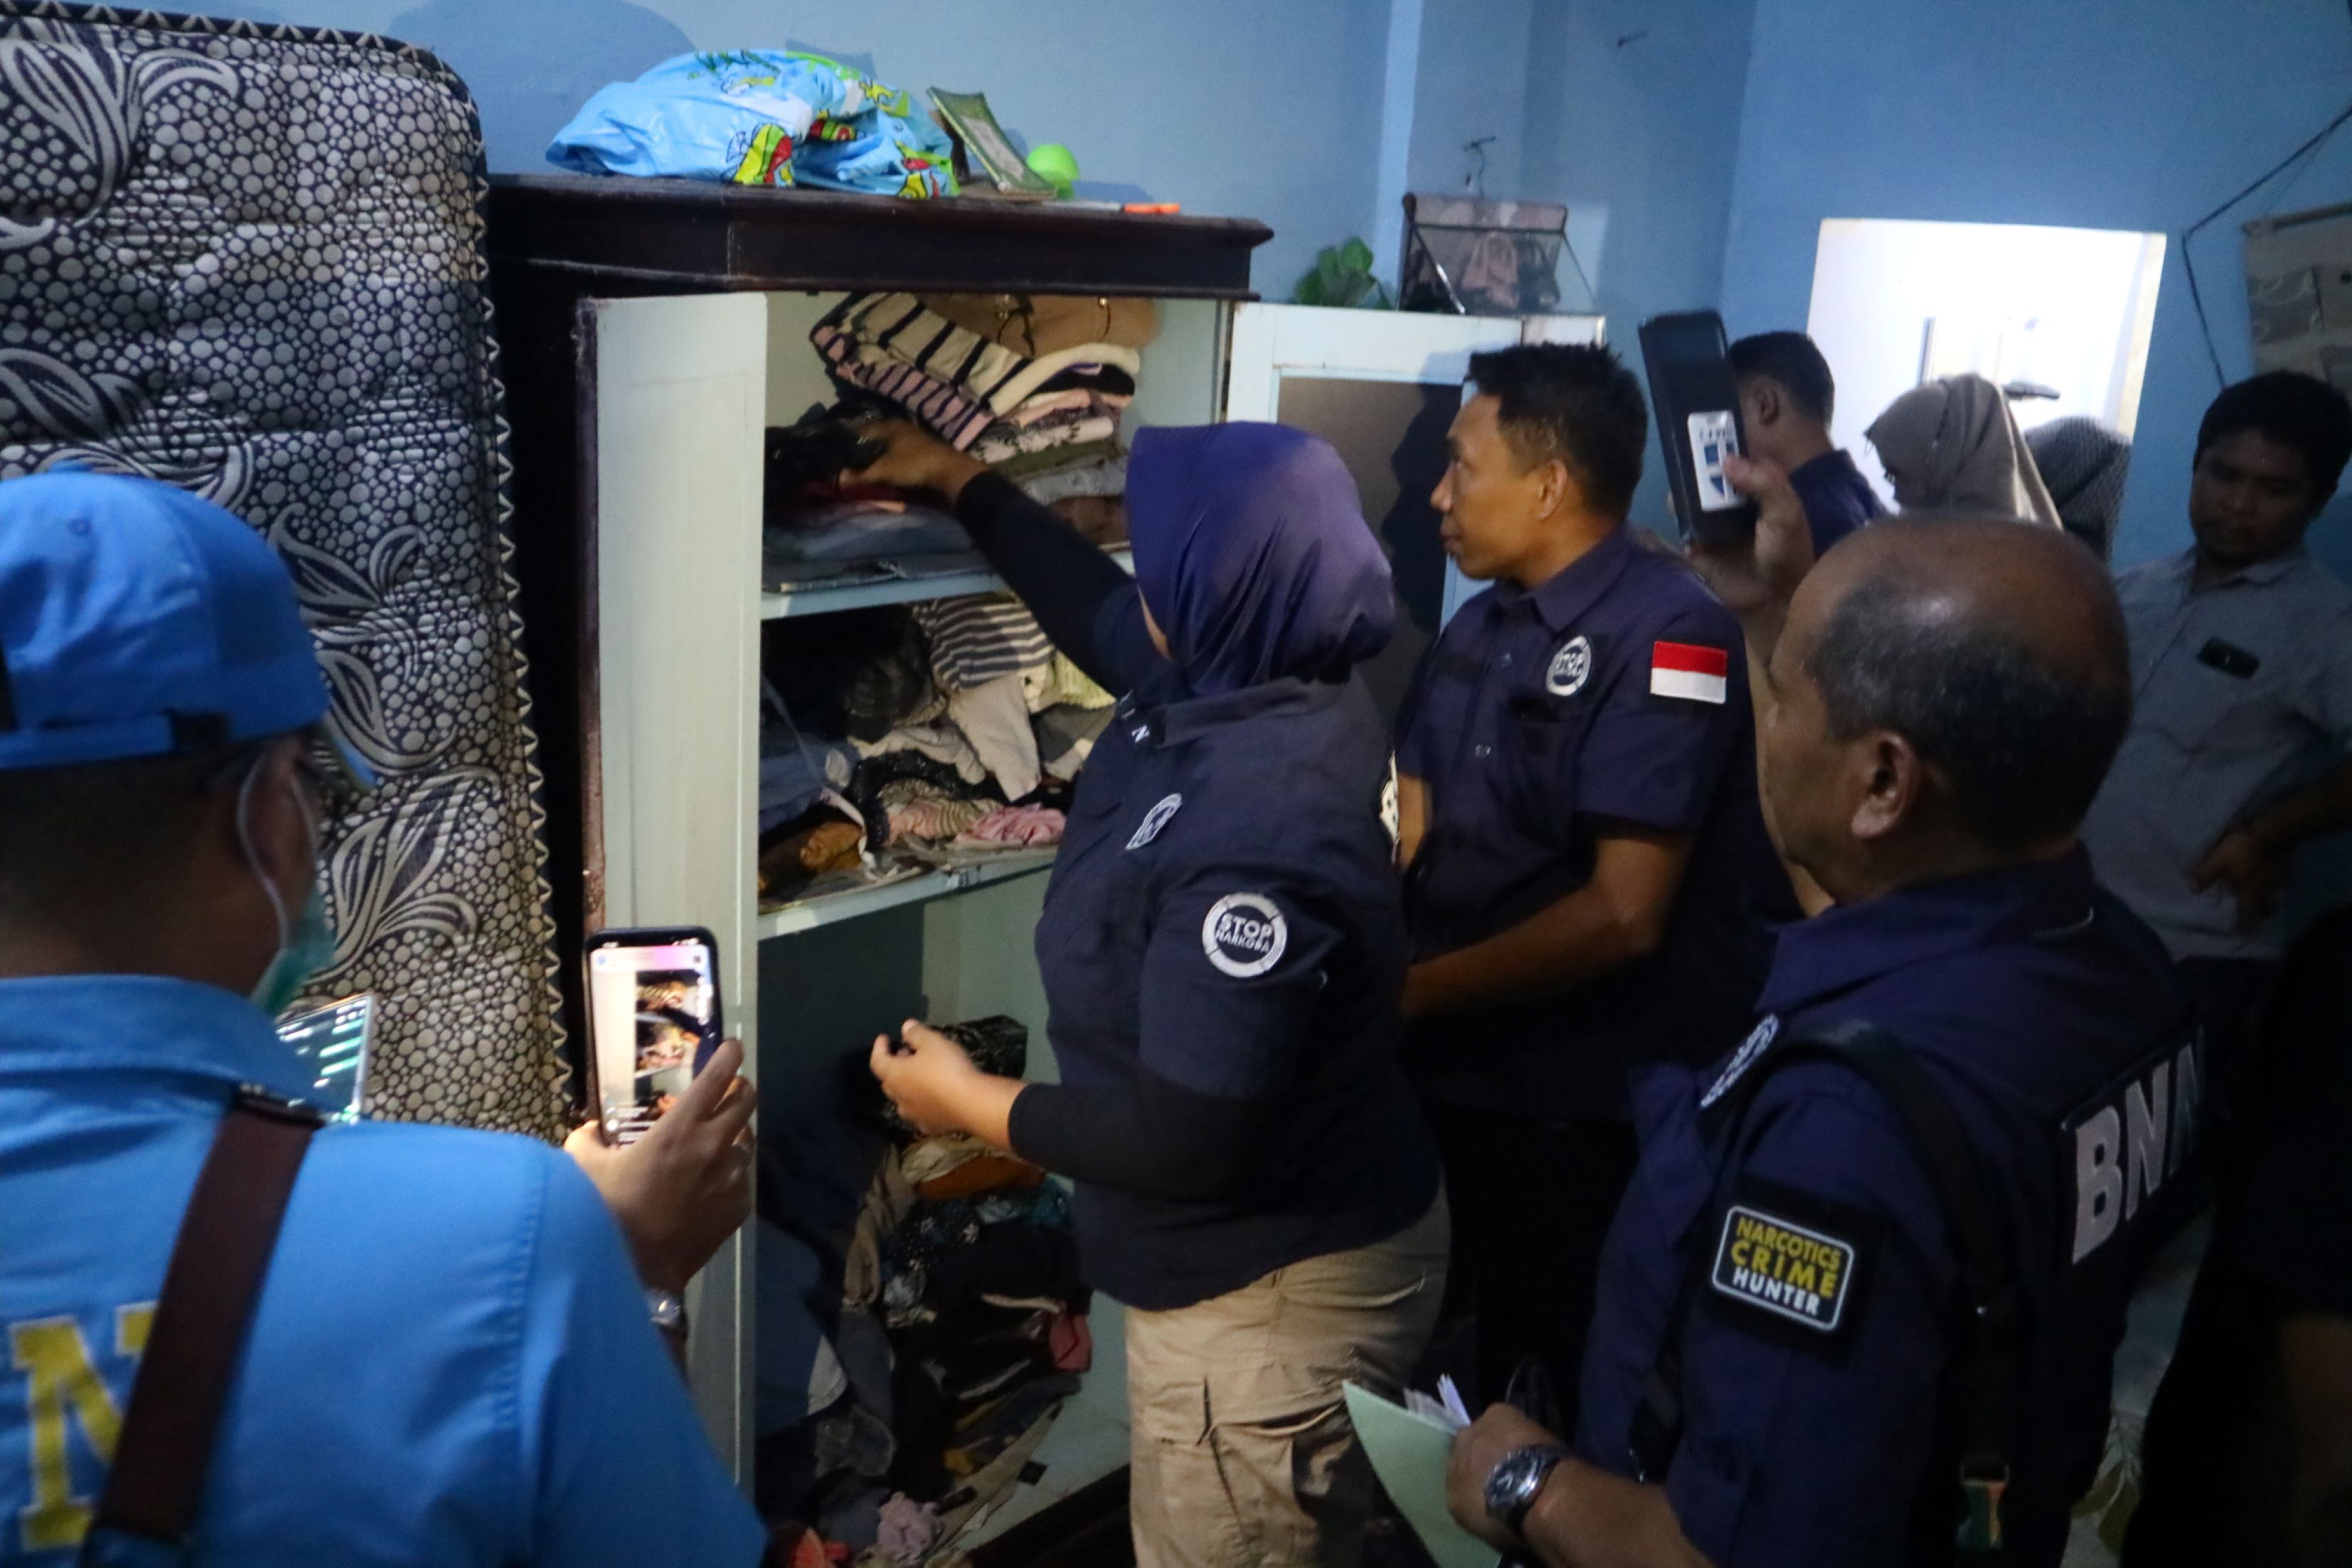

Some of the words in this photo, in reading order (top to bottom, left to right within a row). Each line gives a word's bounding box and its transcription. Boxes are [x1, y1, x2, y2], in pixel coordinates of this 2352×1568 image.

[1219, 912, 1274, 940] STOP
[1731, 1240, 1838, 1299] CRIME
[1736, 1216, 1842, 1273] NARCOTICS
[1733, 1266, 1820, 1316] HUNTER
